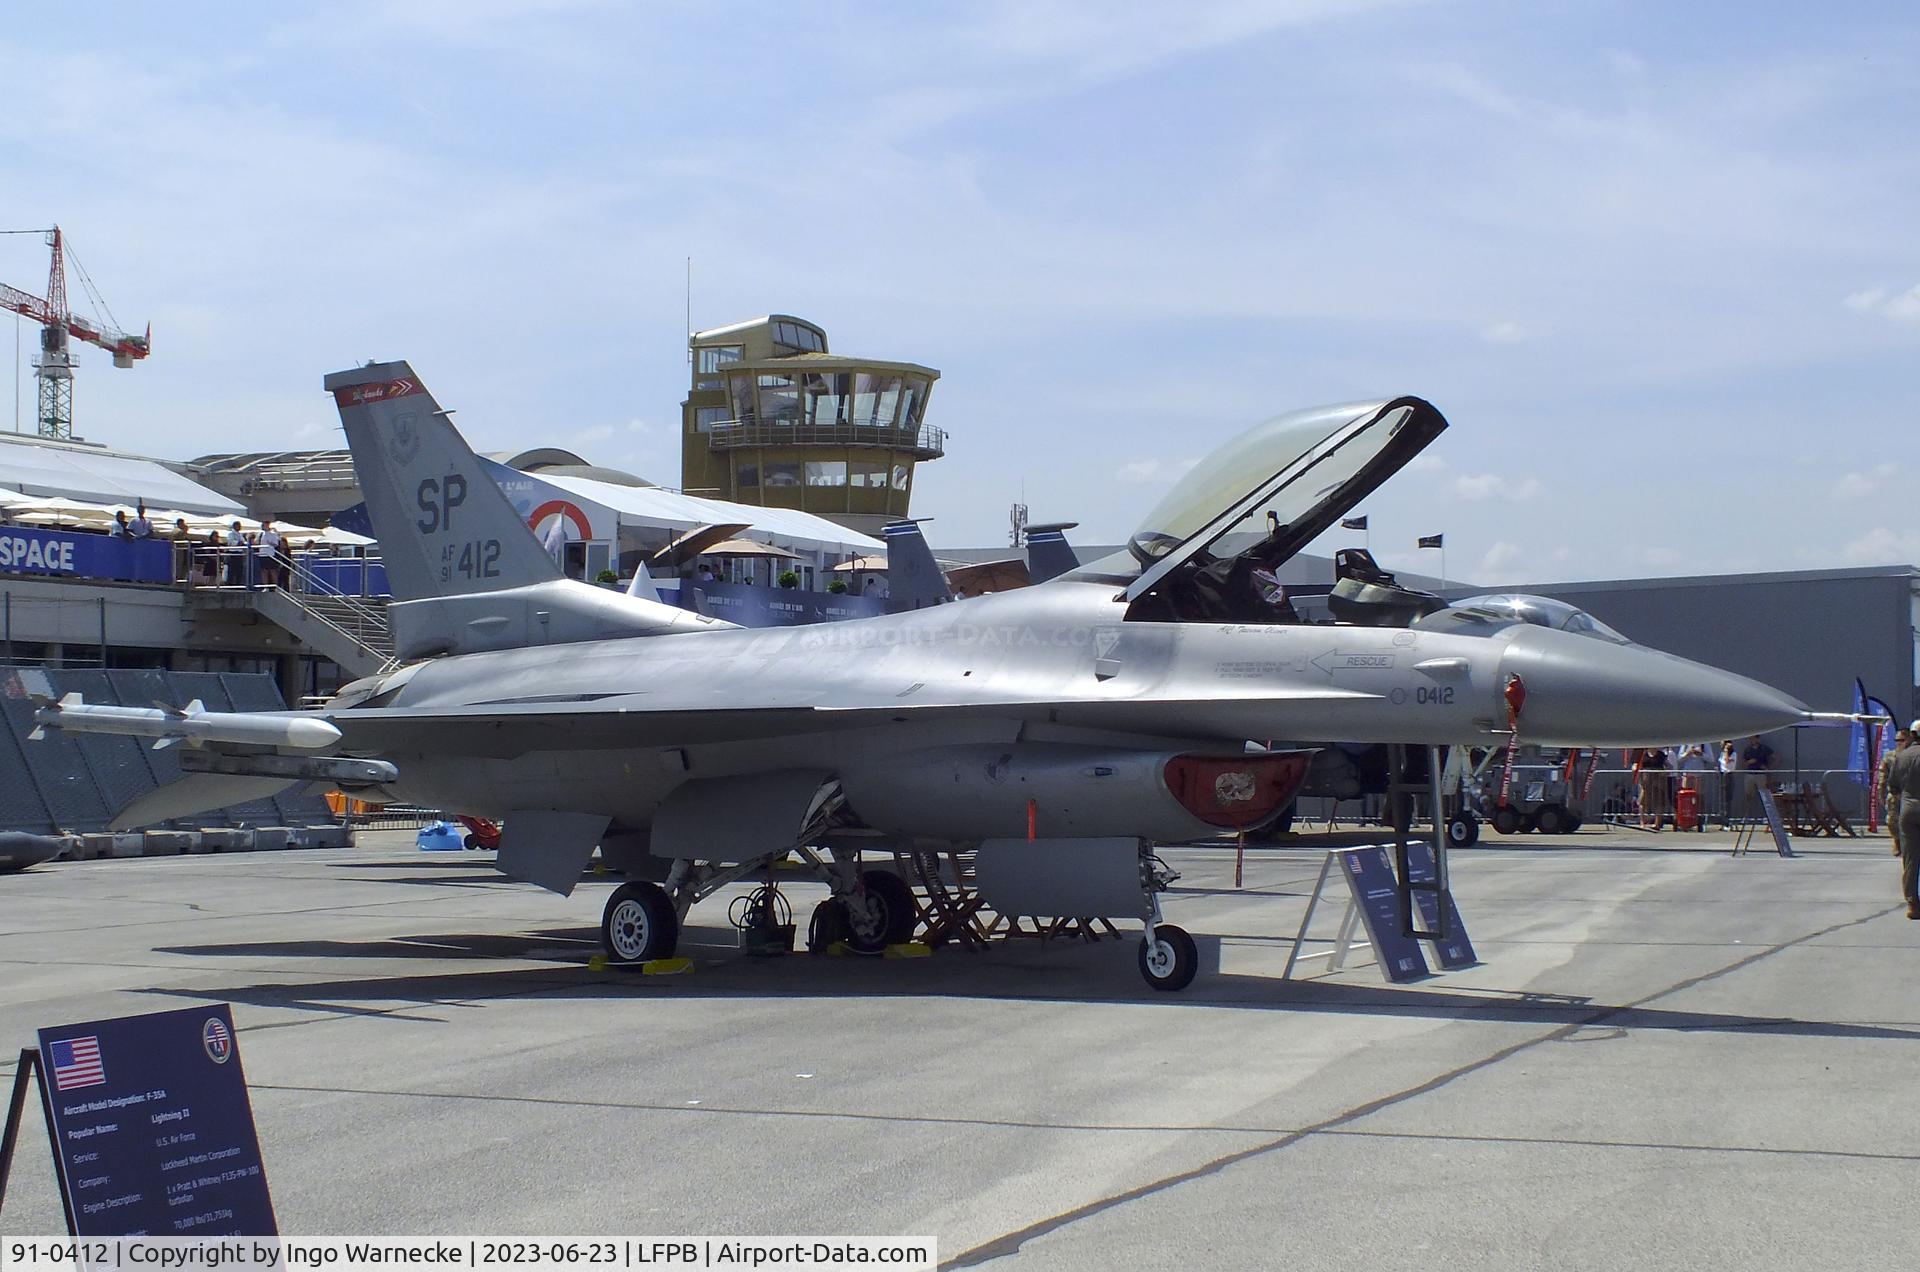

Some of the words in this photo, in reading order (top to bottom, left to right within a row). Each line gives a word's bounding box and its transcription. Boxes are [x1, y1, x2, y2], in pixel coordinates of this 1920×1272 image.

[417, 474, 467, 534] SP
[0, 536, 75, 570] SPACE
[441, 544, 455, 562] AF
[458, 540, 500, 580] 412
[440, 566, 452, 583] 91
[1346, 656, 1388, 666] RESCUE
[1416, 687, 1455, 705] 0412
[64, 1104, 88, 1115] Aircraft
[146, 1090, 167, 1101] F-35A
[68, 1128, 95, 1140] Popular
[96, 1123, 118, 1134] Name:
[151, 1110, 182, 1124] Lightning
[73, 1151, 100, 1164] Service:
[79, 1176, 111, 1188] Company:
[161, 1157, 188, 1171] Lockheed
[83, 1202, 105, 1214] Engine
